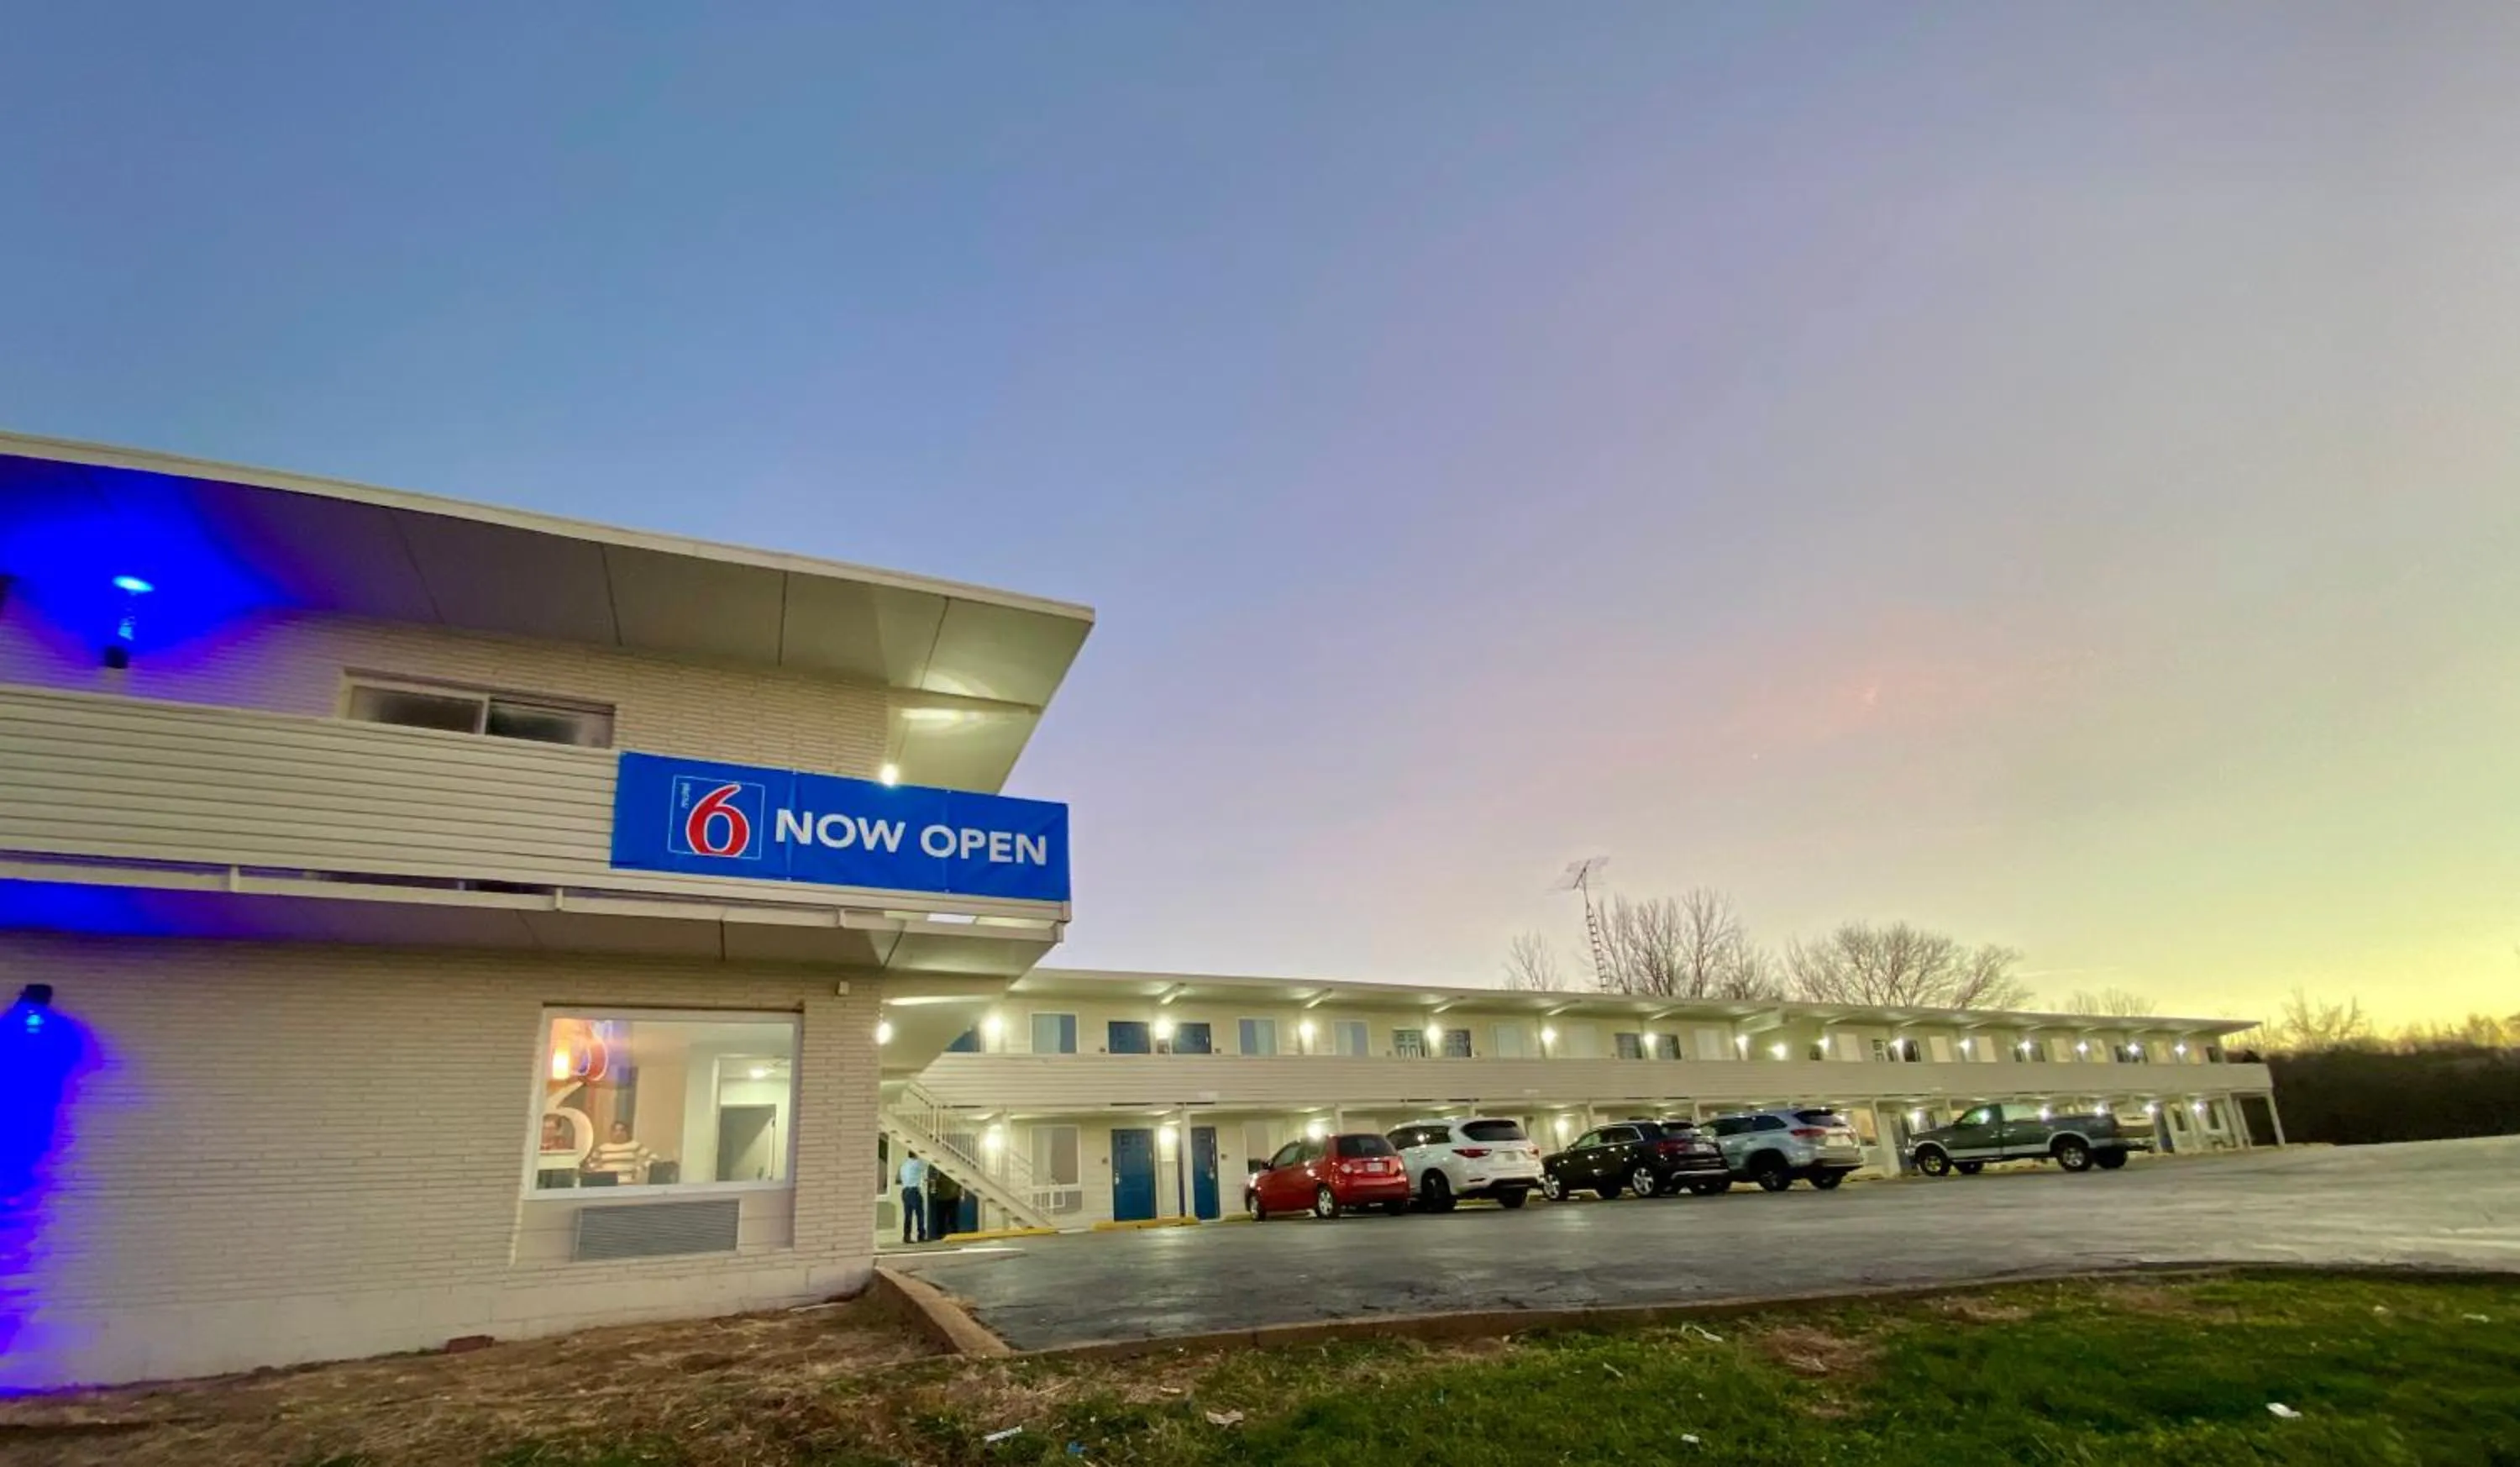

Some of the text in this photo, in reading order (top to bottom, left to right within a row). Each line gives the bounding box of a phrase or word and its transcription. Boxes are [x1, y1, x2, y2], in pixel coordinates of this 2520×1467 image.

[685, 784, 750, 857] 6
[775, 808, 1046, 865] NOW OPEN
